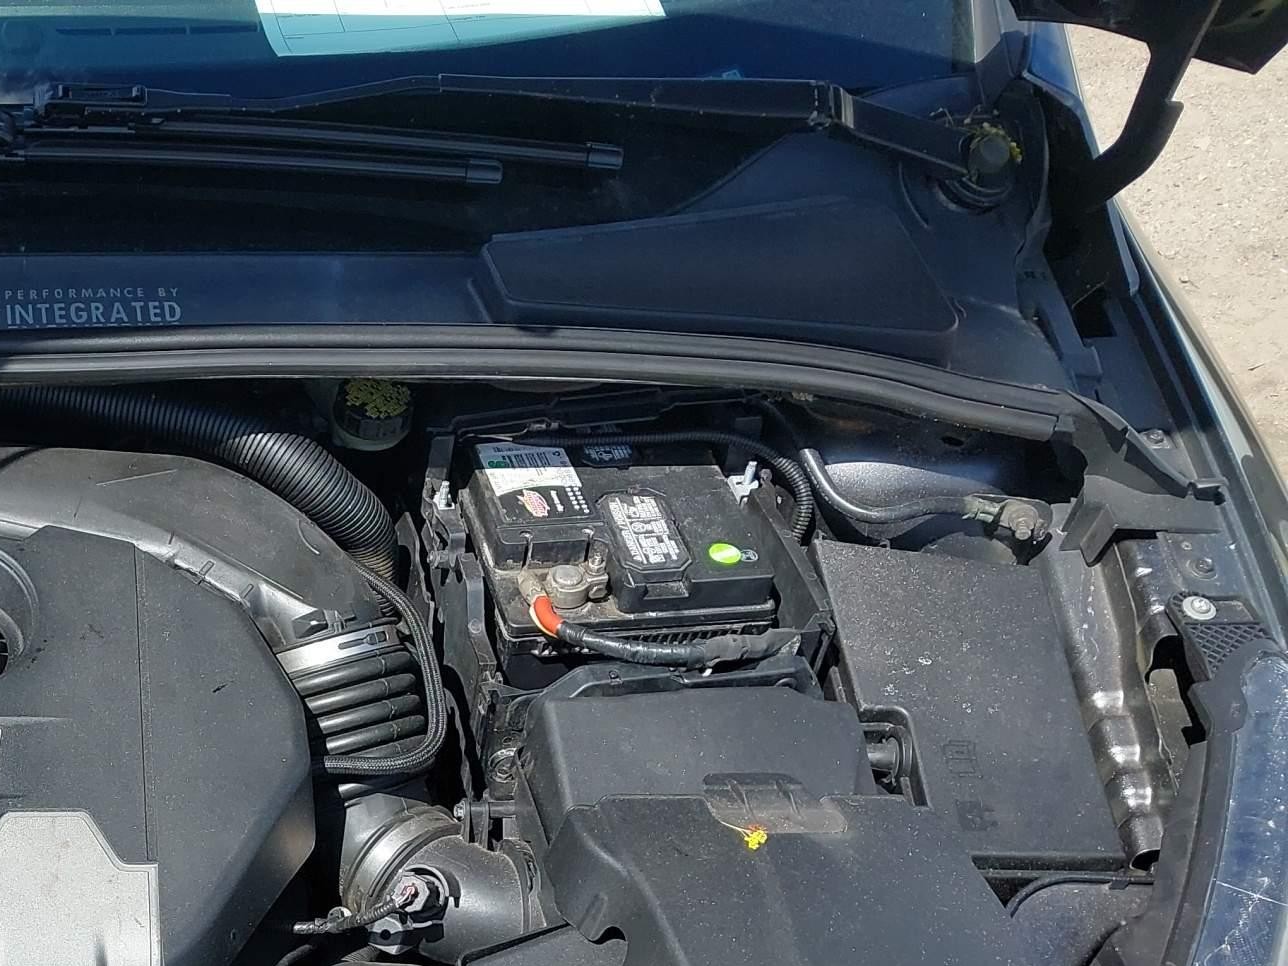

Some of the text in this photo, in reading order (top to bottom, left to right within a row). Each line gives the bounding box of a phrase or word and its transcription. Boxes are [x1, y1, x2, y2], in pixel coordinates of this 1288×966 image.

[4, 287, 179, 300] PERFORMANCE BY
[6, 301, 182, 325] INTEGRATED
